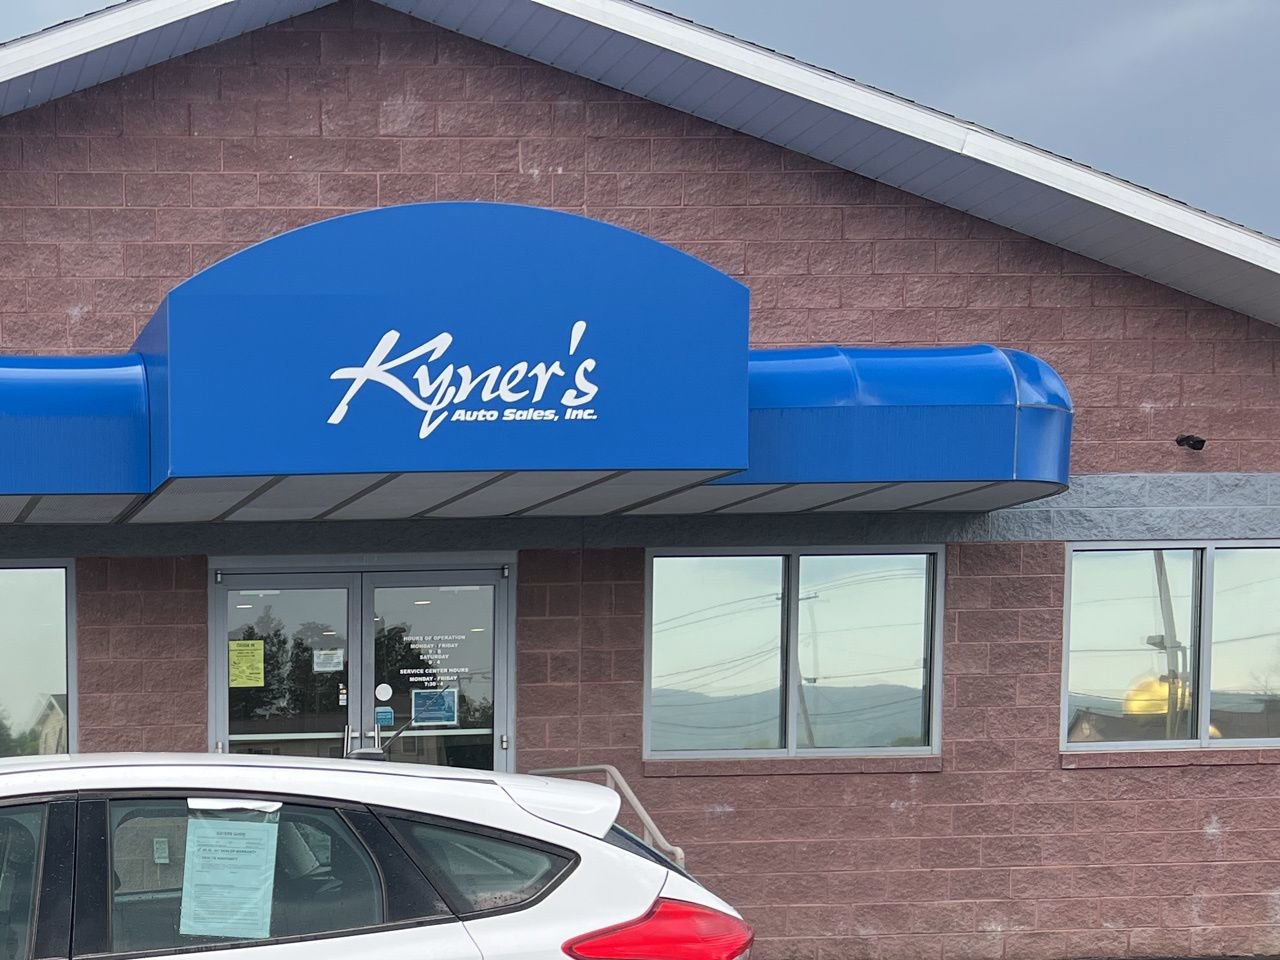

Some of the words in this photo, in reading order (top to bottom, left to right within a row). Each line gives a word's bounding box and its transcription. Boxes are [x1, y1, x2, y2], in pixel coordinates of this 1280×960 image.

[327, 320, 599, 440] Kyner's
[450, 408, 499, 421] Auto
[502, 408, 559, 422] Sales,
[564, 408, 598, 420] Inc.
